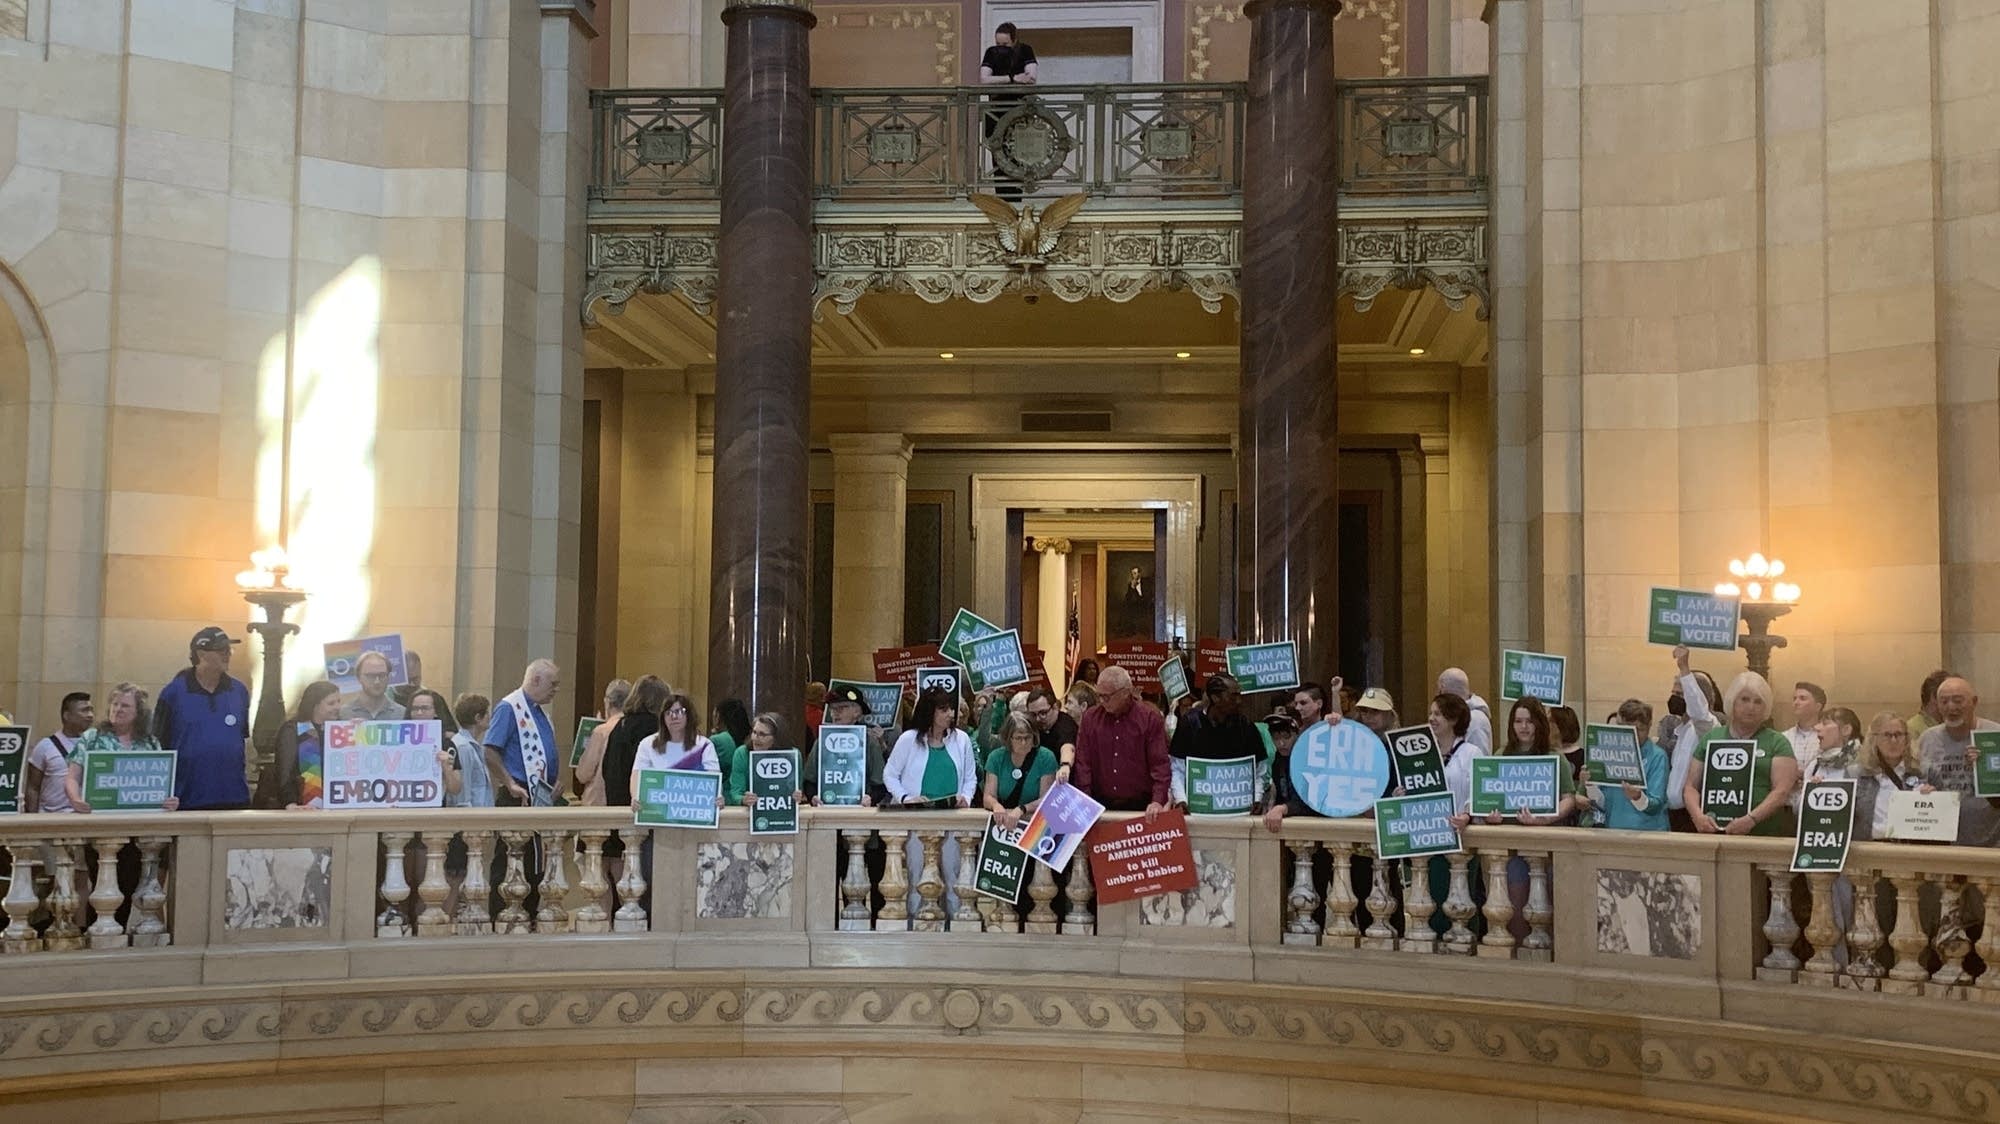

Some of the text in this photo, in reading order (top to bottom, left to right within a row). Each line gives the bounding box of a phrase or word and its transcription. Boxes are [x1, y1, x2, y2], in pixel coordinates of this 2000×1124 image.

[1679, 598, 1683, 609] I
[1687, 598, 1710, 611] AM
[1714, 600, 1733, 612] AN
[1661, 611, 1733, 628] EQUALITY
[1683, 630, 1731, 643] VOTER
[975, 638, 1015, 656] I AM AN
[899, 651, 911, 659] NO
[1108, 653, 1166, 661] CONSTITUTIONAL
[1250, 652, 1253, 662] I
[1256, 650, 1274, 662] AM
[1276, 648, 1292, 659] AN
[877, 655, 935, 670] CONSTITUTIONAL
[970, 653, 1017, 673] EQUALITY
[1239, 660, 1293, 675] EQUALITY
[1523, 658, 1527, 669] I
[1527, 658, 1544, 672] AM
[1545, 661, 1560, 673] AN
[984, 665, 1022, 682] VOTER
[1258, 671, 1295, 683] VOTER
[1511, 670, 1560, 686] EQUALITY
[926, 678, 952, 690] YES
[882, 690, 898, 700] AN
[1524, 685, 1559, 699] VOTER
[0, 737, 17, 751] ES
[829, 736, 857, 750] YES
[1398, 737, 1429, 753] YES
[1600, 734, 1604, 745] I
[1604, 735, 1618, 747] AM
[1622, 736, 1634, 747] AN
[1306, 724, 1374, 773] ERA
[1590, 749, 1637, 763] EQUALITY
[1715, 753, 1744, 767] YES
[116, 761, 120, 771] I
[124, 760, 147, 772] AM
[150, 760, 170, 771] AN
[760, 762, 788, 776] YES
[1413, 760, 1425, 768] on
[824, 770, 859, 785] ERA!
[1208, 768, 1212, 780] I
[1215, 768, 1236, 780] AM
[1238, 766, 1253, 779] AN
[1501, 765, 1505, 777] I
[1509, 766, 1530, 778] AM
[1533, 765, 1552, 777] AN
[1606, 765, 1641, 780] VOTER
[98, 775, 168, 788] EQUALITY
[666, 777, 670, 789] I
[673, 778, 694, 790] AM
[697, 780, 715, 793] AN
[1195, 780, 1254, 794] EQUALITY
[1404, 770, 1442, 791] ERA!
[1484, 780, 1553, 793] EQUALITY
[121, 790, 166, 803] VOTER
[329, 778, 438, 804] EMBODIED
[1302, 771, 1377, 809] YES
[651, 791, 714, 806] EQUALITY
[756, 797, 793, 811] ERA!
[1214, 794, 1253, 809] VOTER
[1507, 795, 1553, 808] VOTER
[1707, 789, 1744, 806] ERA!
[1813, 792, 1844, 807] YES
[1403, 807, 1407, 818] I
[1411, 804, 1431, 817] AM
[1433, 801, 1451, 814] AN
[1914, 801, 1935, 809] ERA
[670, 807, 713, 820] VOTER
[1389, 817, 1451, 835] EQUALITY
[1819, 817, 1832, 825] on
[998, 826, 1022, 845] YES
[1126, 823, 1144, 835] NO
[1093, 828, 1184, 854] CONSTITUTIONAL
[1412, 832, 1455, 846] VOTER
[1803, 831, 1844, 848] ERA!
[999, 849, 1010, 858] on
[1107, 840, 1174, 862] AMENDMENT
[983, 858, 1018, 881] ERA!
[1127, 857, 1159, 872] to kill
[1106, 864, 1185, 887] unborn babies
